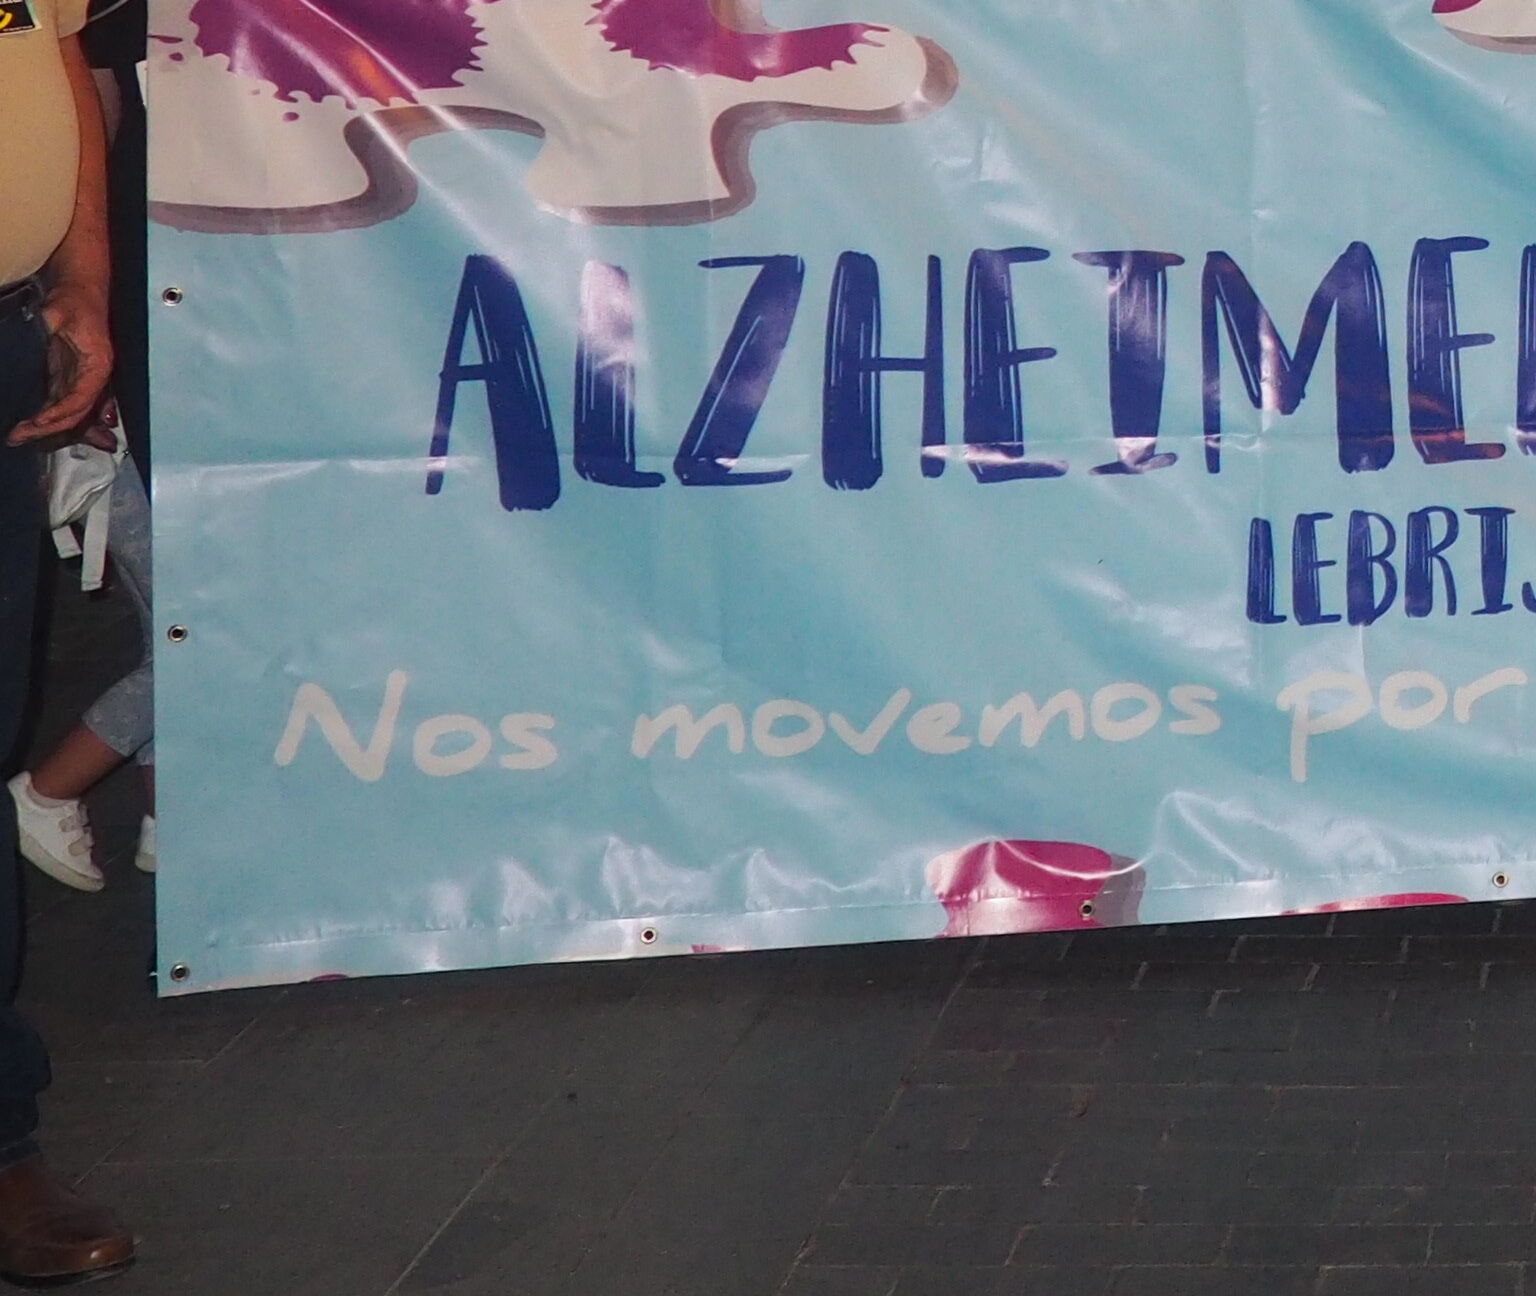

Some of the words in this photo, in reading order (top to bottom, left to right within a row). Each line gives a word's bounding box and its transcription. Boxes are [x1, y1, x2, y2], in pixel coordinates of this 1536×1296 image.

[274, 671, 560, 781] Nos
[631, 677, 1221, 761] movemos
[1277, 664, 1528, 783] por
